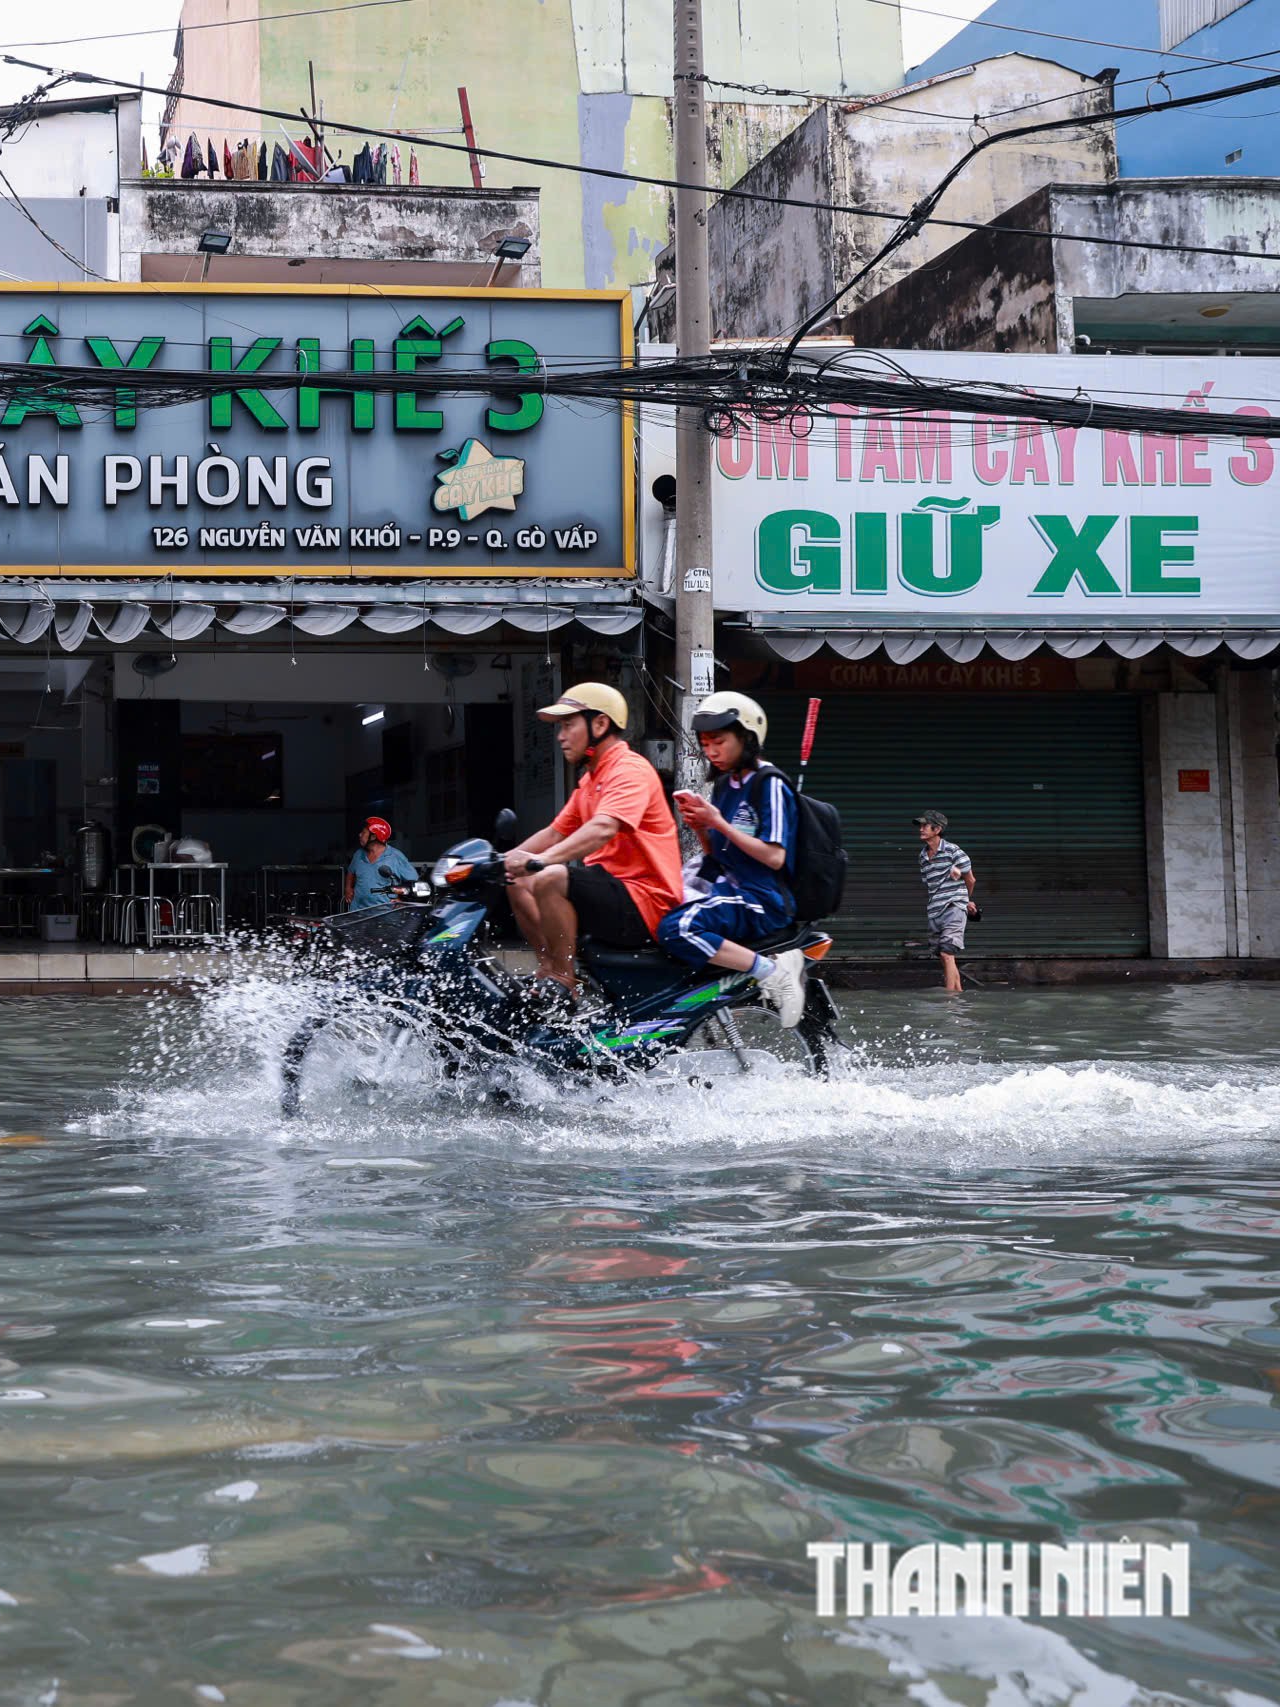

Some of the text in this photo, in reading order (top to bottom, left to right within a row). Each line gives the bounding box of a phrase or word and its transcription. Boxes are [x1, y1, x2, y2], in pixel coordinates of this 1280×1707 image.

[208, 315, 465, 431] KHẾ
[485, 338, 545, 432] 3
[104, 442, 333, 507] PHÒNG
[715, 390, 809, 480] ƠM
[1102, 381, 1215, 487] KHẾ
[1228, 405, 1275, 487] 3
[153, 527, 189, 547] 126
[200, 521, 286, 547] NGUYỄN
[295, 524, 340, 547] VĂN
[350, 522, 401, 547] KHỐI
[429, 528, 461, 547] P.9
[486, 528, 508, 549] Q.
[516, 525, 545, 548] GÒ
[554, 523, 598, 549] VẤP
[754, 496, 1201, 598] GIỮ XE
